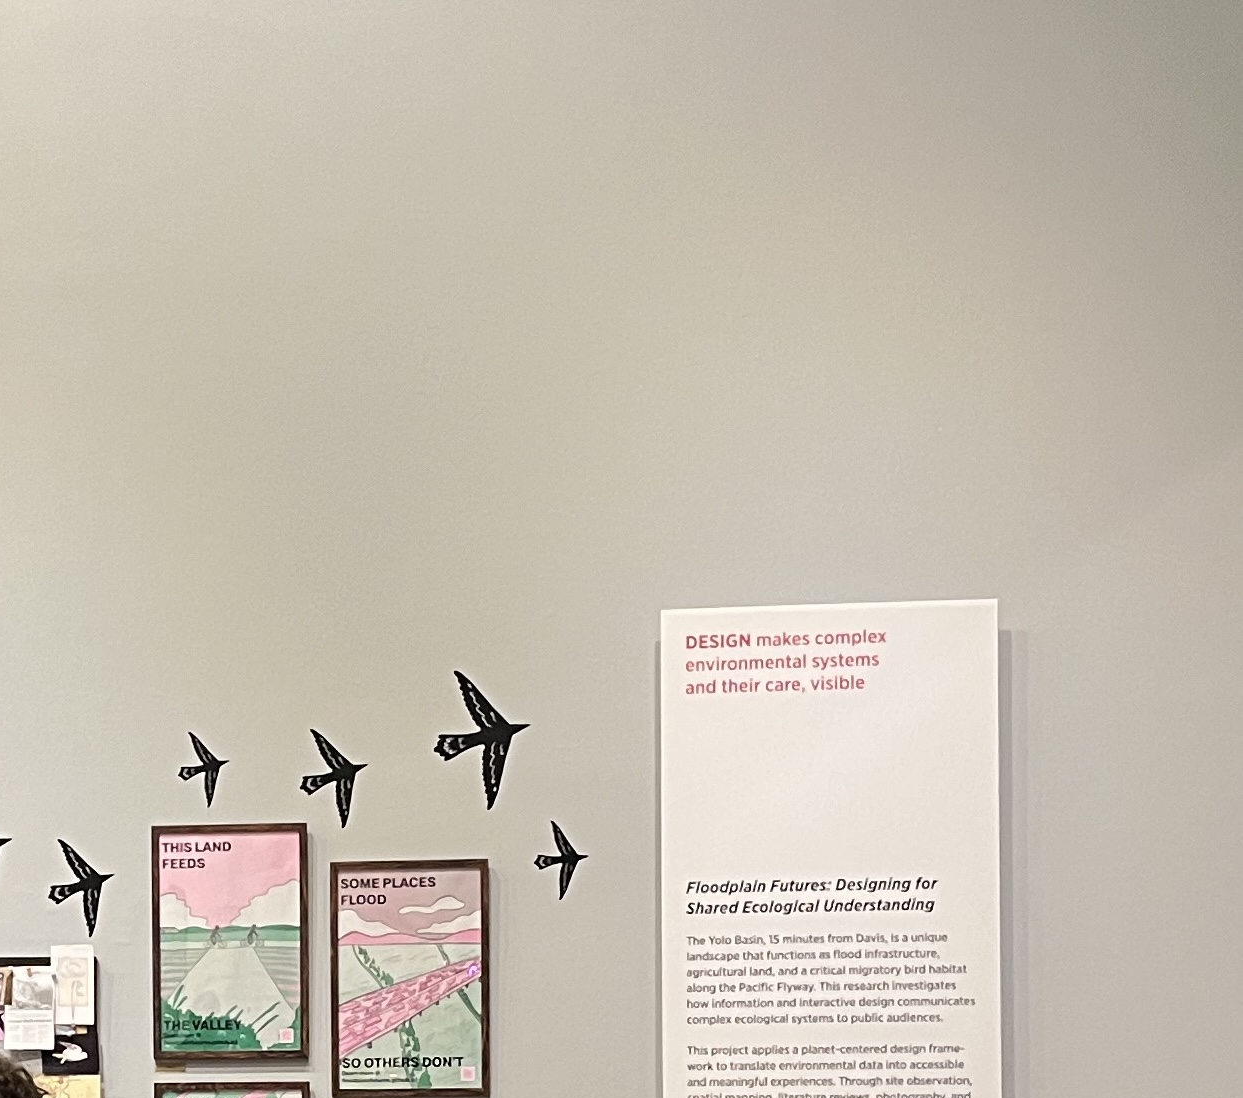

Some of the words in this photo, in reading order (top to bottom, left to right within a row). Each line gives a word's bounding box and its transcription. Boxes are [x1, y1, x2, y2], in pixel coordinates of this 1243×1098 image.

[686, 631, 751, 649] DESIGN
[757, 629, 810, 647] makes
[815, 628, 886, 650] complex
[686, 653, 807, 672] environmental
[812, 652, 879, 672] systems
[686, 678, 716, 695] and
[722, 677, 760, 693] their
[766, 680, 805, 694] care,
[811, 675, 865, 691] visible
[162, 842, 192, 853] THIS
[195, 841, 231, 852] LAND
[162, 858, 206, 869] FEEDS
[340, 878, 380, 889] SOME
[383, 877, 436, 888] PLACES
[686, 879, 766, 897] Floodplain
[770, 878, 832, 892] Futures:
[835, 877, 911, 895] Designing
[915, 876, 940, 890] for
[340, 894, 387, 906] FLOOD
[686, 899, 739, 914] Shared
[742, 898, 819, 917] Ecological
[823, 897, 935, 916] Understanding
[687, 935, 706, 946] The
[709, 935, 732, 946] Yolo
[769, 933, 780, 944] 15
[783, 933, 825, 944] minutes
[828, 933, 853, 944] from
[902, 935, 908, 943] a
[911, 932, 949, 946] unique
[686, 950, 740, 964] landscape
[743, 949, 764, 960] that
[767, 949, 816, 960] functions
[819, 952, 831, 960] as
[833, 949, 862, 960] flood
[686, 965, 747, 980] agricultural
[778, 965, 798, 976] and
[801, 968, 807, 976] a
[810, 965, 846, 976] critical
[849, 964, 901, 978] migratory
[904, 964, 926, 975] bird
[929, 964, 968, 975] habitat
[687, 981, 716, 995] along
[719, 981, 736, 992] the
[739, 981, 774, 992] Pacific
[820, 980, 841, 991] This
[844, 980, 890, 991] research
[892, 980, 958, 994] investigates
[686, 997, 709, 1008] how
[712, 997, 774, 1008] information
[777, 997, 797, 1007] and
[799, 997, 856, 1007] interactive
[859, 996, 895, 1010] design
[897, 996, 977, 1007] communicates
[164, 1020, 190, 1030] THE
[192, 1020, 241, 1030] VALLEY
[687, 1013, 731, 1027] complex
[735, 1013, 789, 1026] ecological
[792, 1013, 834, 1026] systems
[837, 1013, 848, 1023] to
[851, 1013, 884, 1026] public
[687, 1045, 708, 1055] This
[711, 1045, 748, 1058] project
[752, 1044, 790, 1057] applies
[890, 1044, 926, 1056] design
[342, 1058, 361, 1068] SO
[364, 1057, 419, 1068] OTHERS
[423, 1057, 464, 1067] DON'T
[687, 1061, 713, 1071] work
[716, 1060, 727, 1071] to
[730, 1060, 776, 1071] translate
[779, 1060, 856, 1070] environmental
[859, 1060, 883, 1070] data
[886, 1060, 907, 1070] into
[910, 1059, 965, 1070] accessible
[687, 1076, 707, 1087] and
[709, 1076, 768, 1089] meaningful
[840, 1076, 883, 1089] Through
[885, 1076, 904, 1086] site
